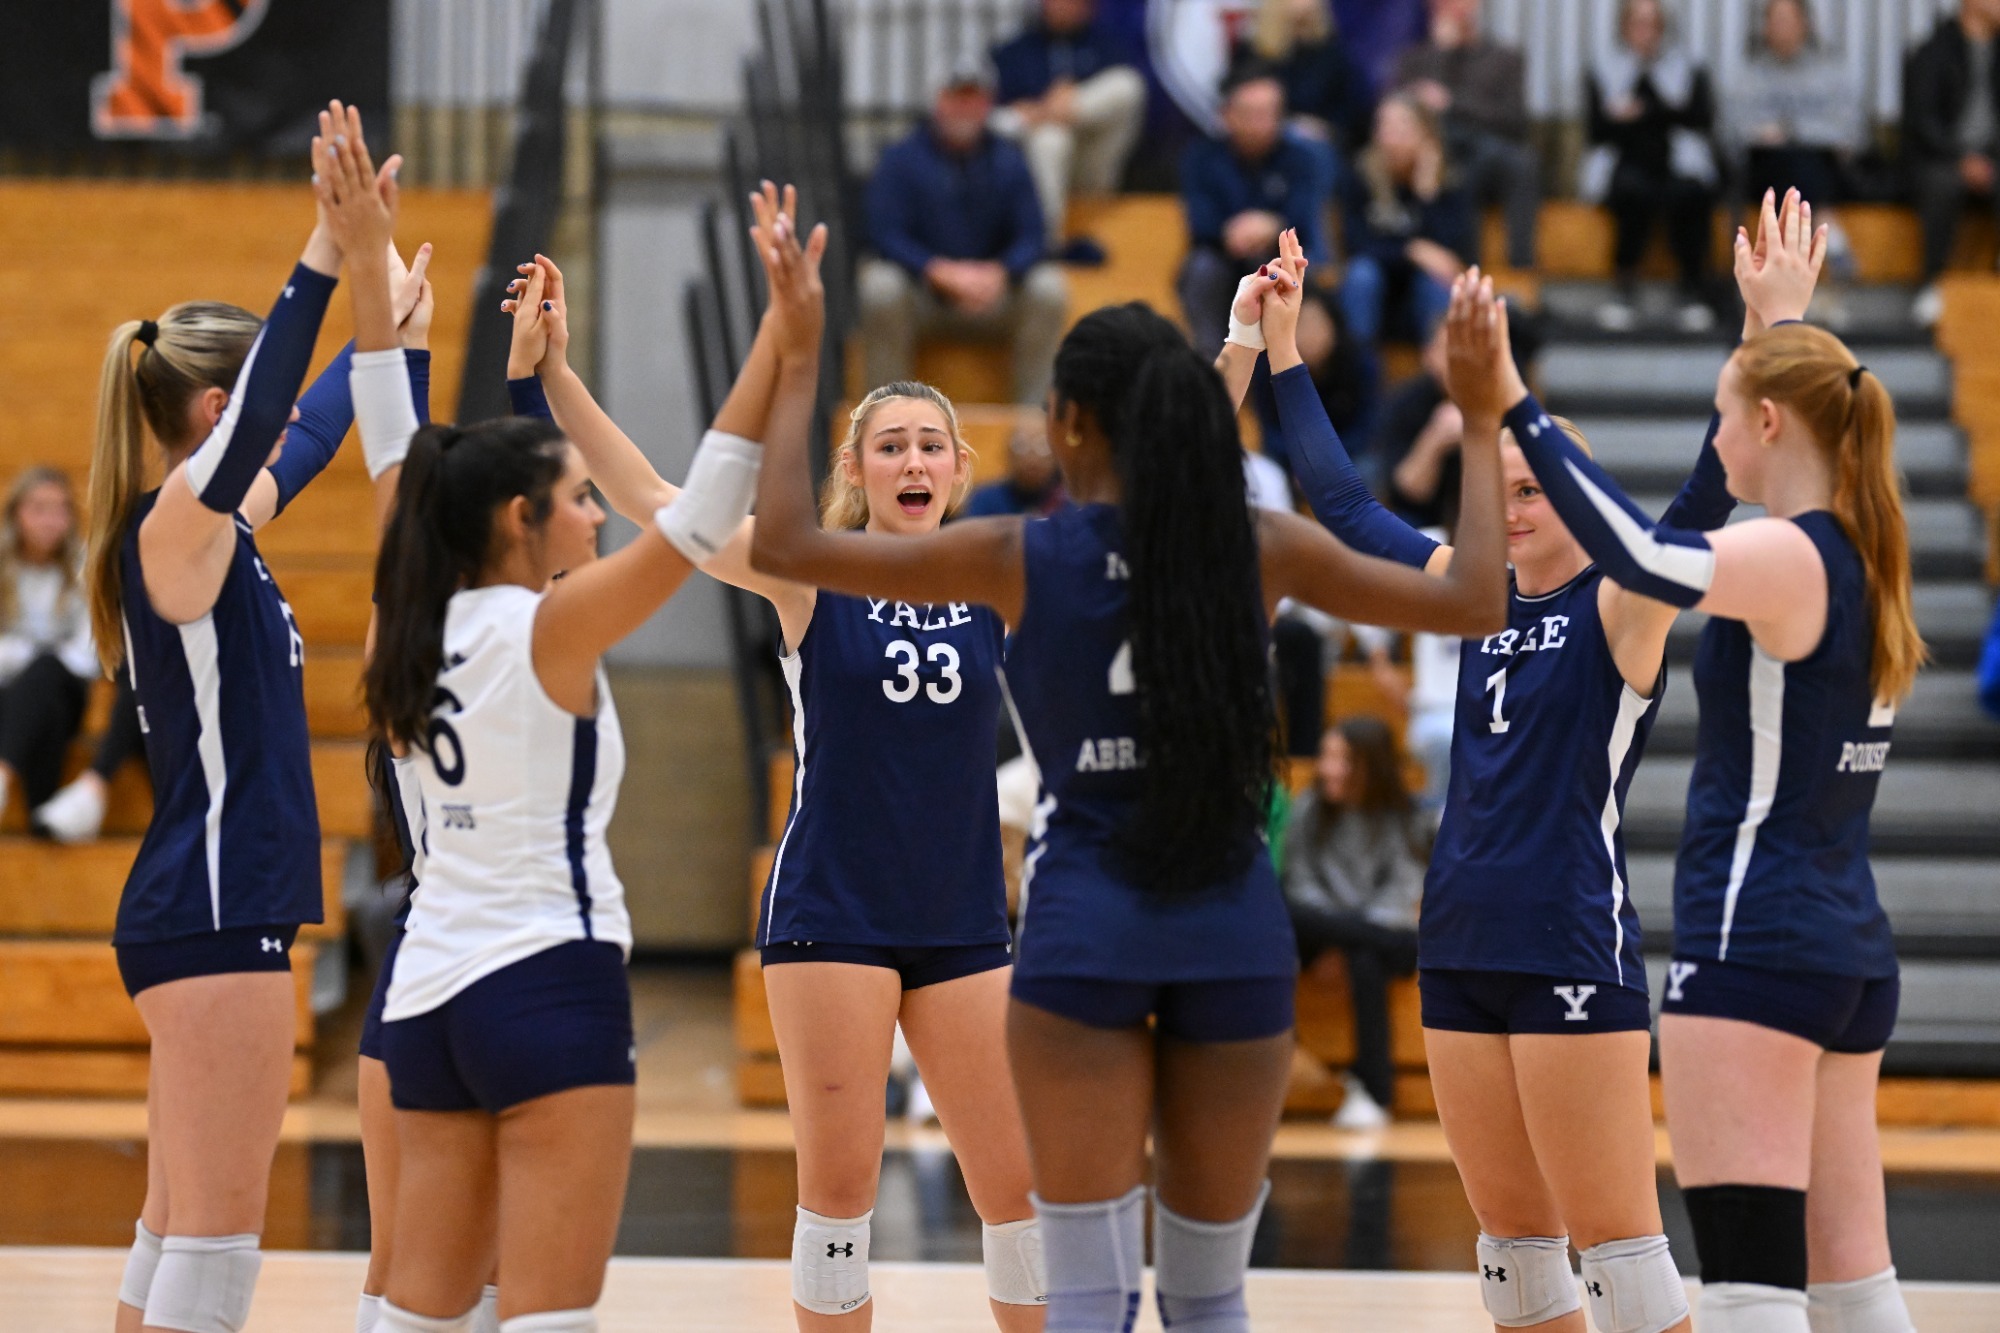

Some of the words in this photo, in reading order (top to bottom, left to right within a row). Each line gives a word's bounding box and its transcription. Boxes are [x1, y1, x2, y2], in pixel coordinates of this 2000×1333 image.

[88, 0, 268, 139] P
[866, 595, 972, 631] YALE
[882, 639, 962, 704] 33
[1486, 667, 1511, 734] 1
[428, 686, 467, 787] 6
[1076, 737, 1147, 772] ABR
[1553, 984, 1597, 1021] Y
[1667, 961, 1699, 1001] Y
